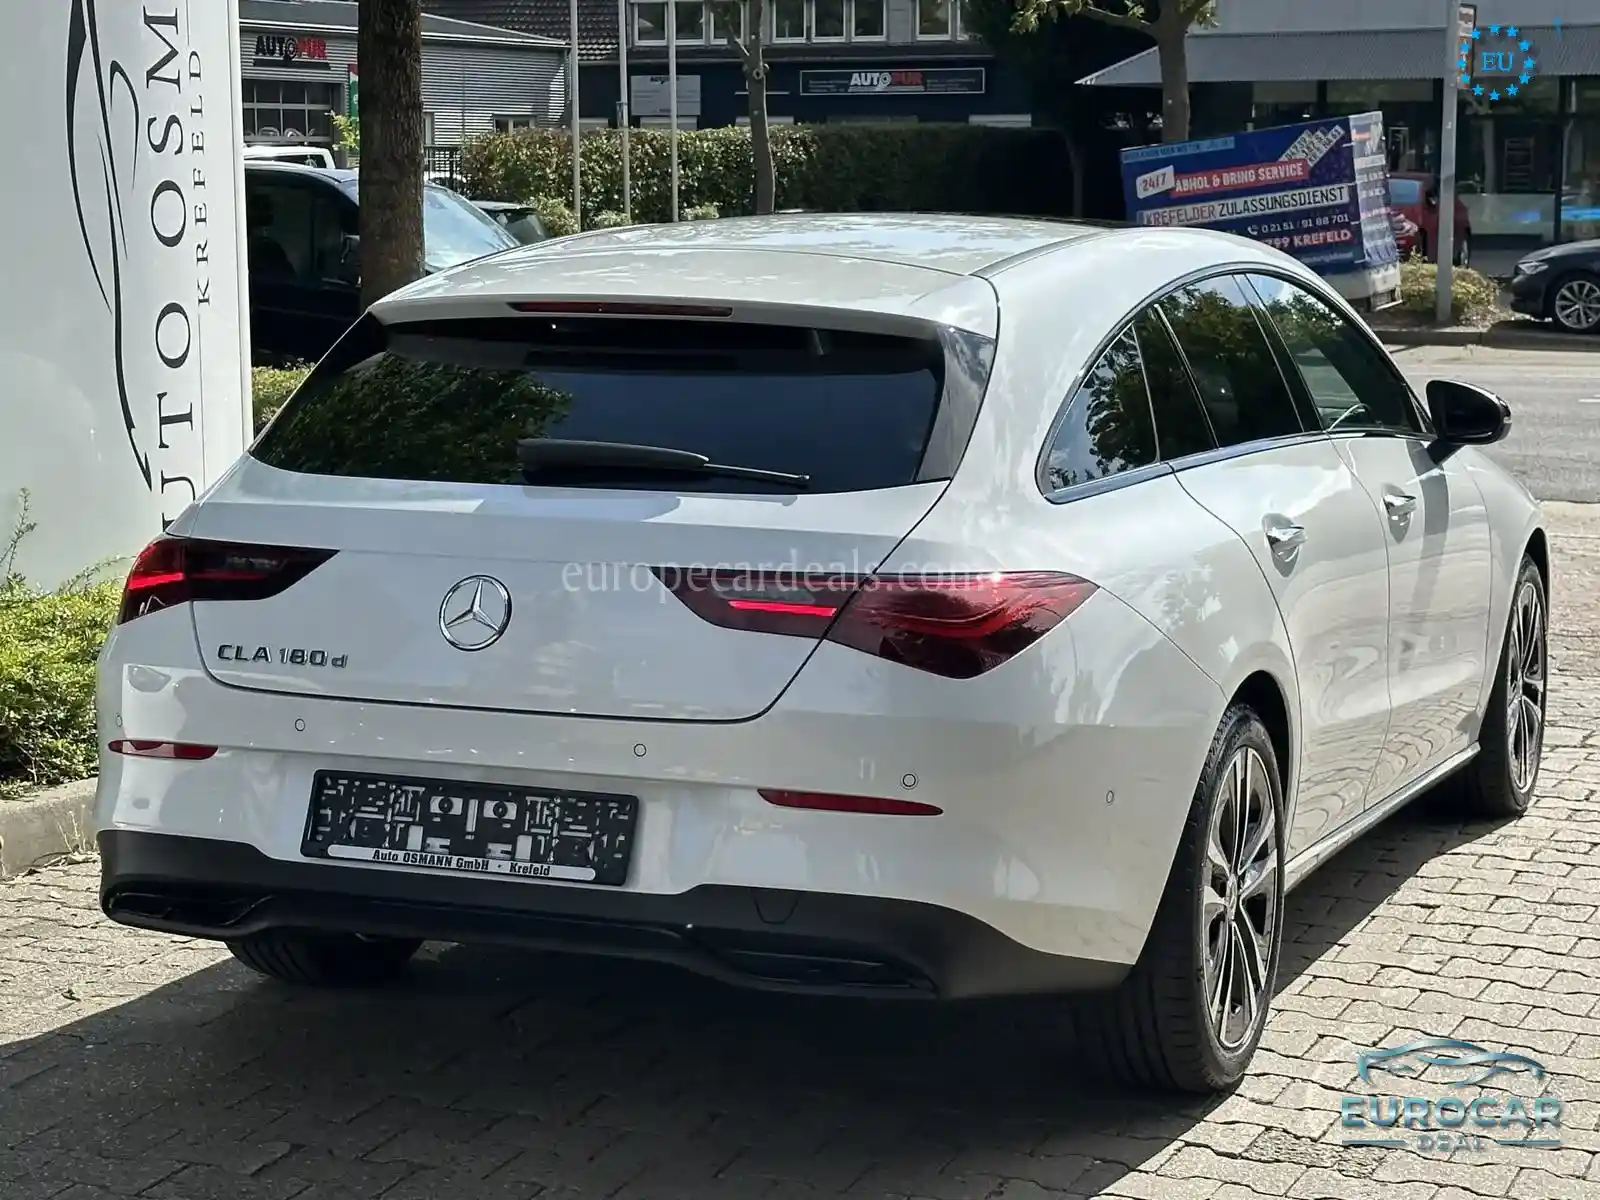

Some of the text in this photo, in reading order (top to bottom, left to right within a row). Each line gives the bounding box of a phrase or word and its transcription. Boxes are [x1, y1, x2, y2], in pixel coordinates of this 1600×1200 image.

[187, 48, 212, 307] KREFELD
[1175, 175, 1211, 193] ABHOL
[1222, 170, 1256, 186] BRING
[1257, 163, 1304, 182] SERVICE
[1145, 203, 1216, 225] KREFELDER
[1218, 186, 1345, 217] ZULASSUNGSDIENST
[1293, 229, 1352, 248] KREFELD
[155, 302, 195, 533] UTO
[217, 644, 349, 669] CLA 180 d
[372, 849, 551, 876] Auto OSMANN GmbH Krefeld
